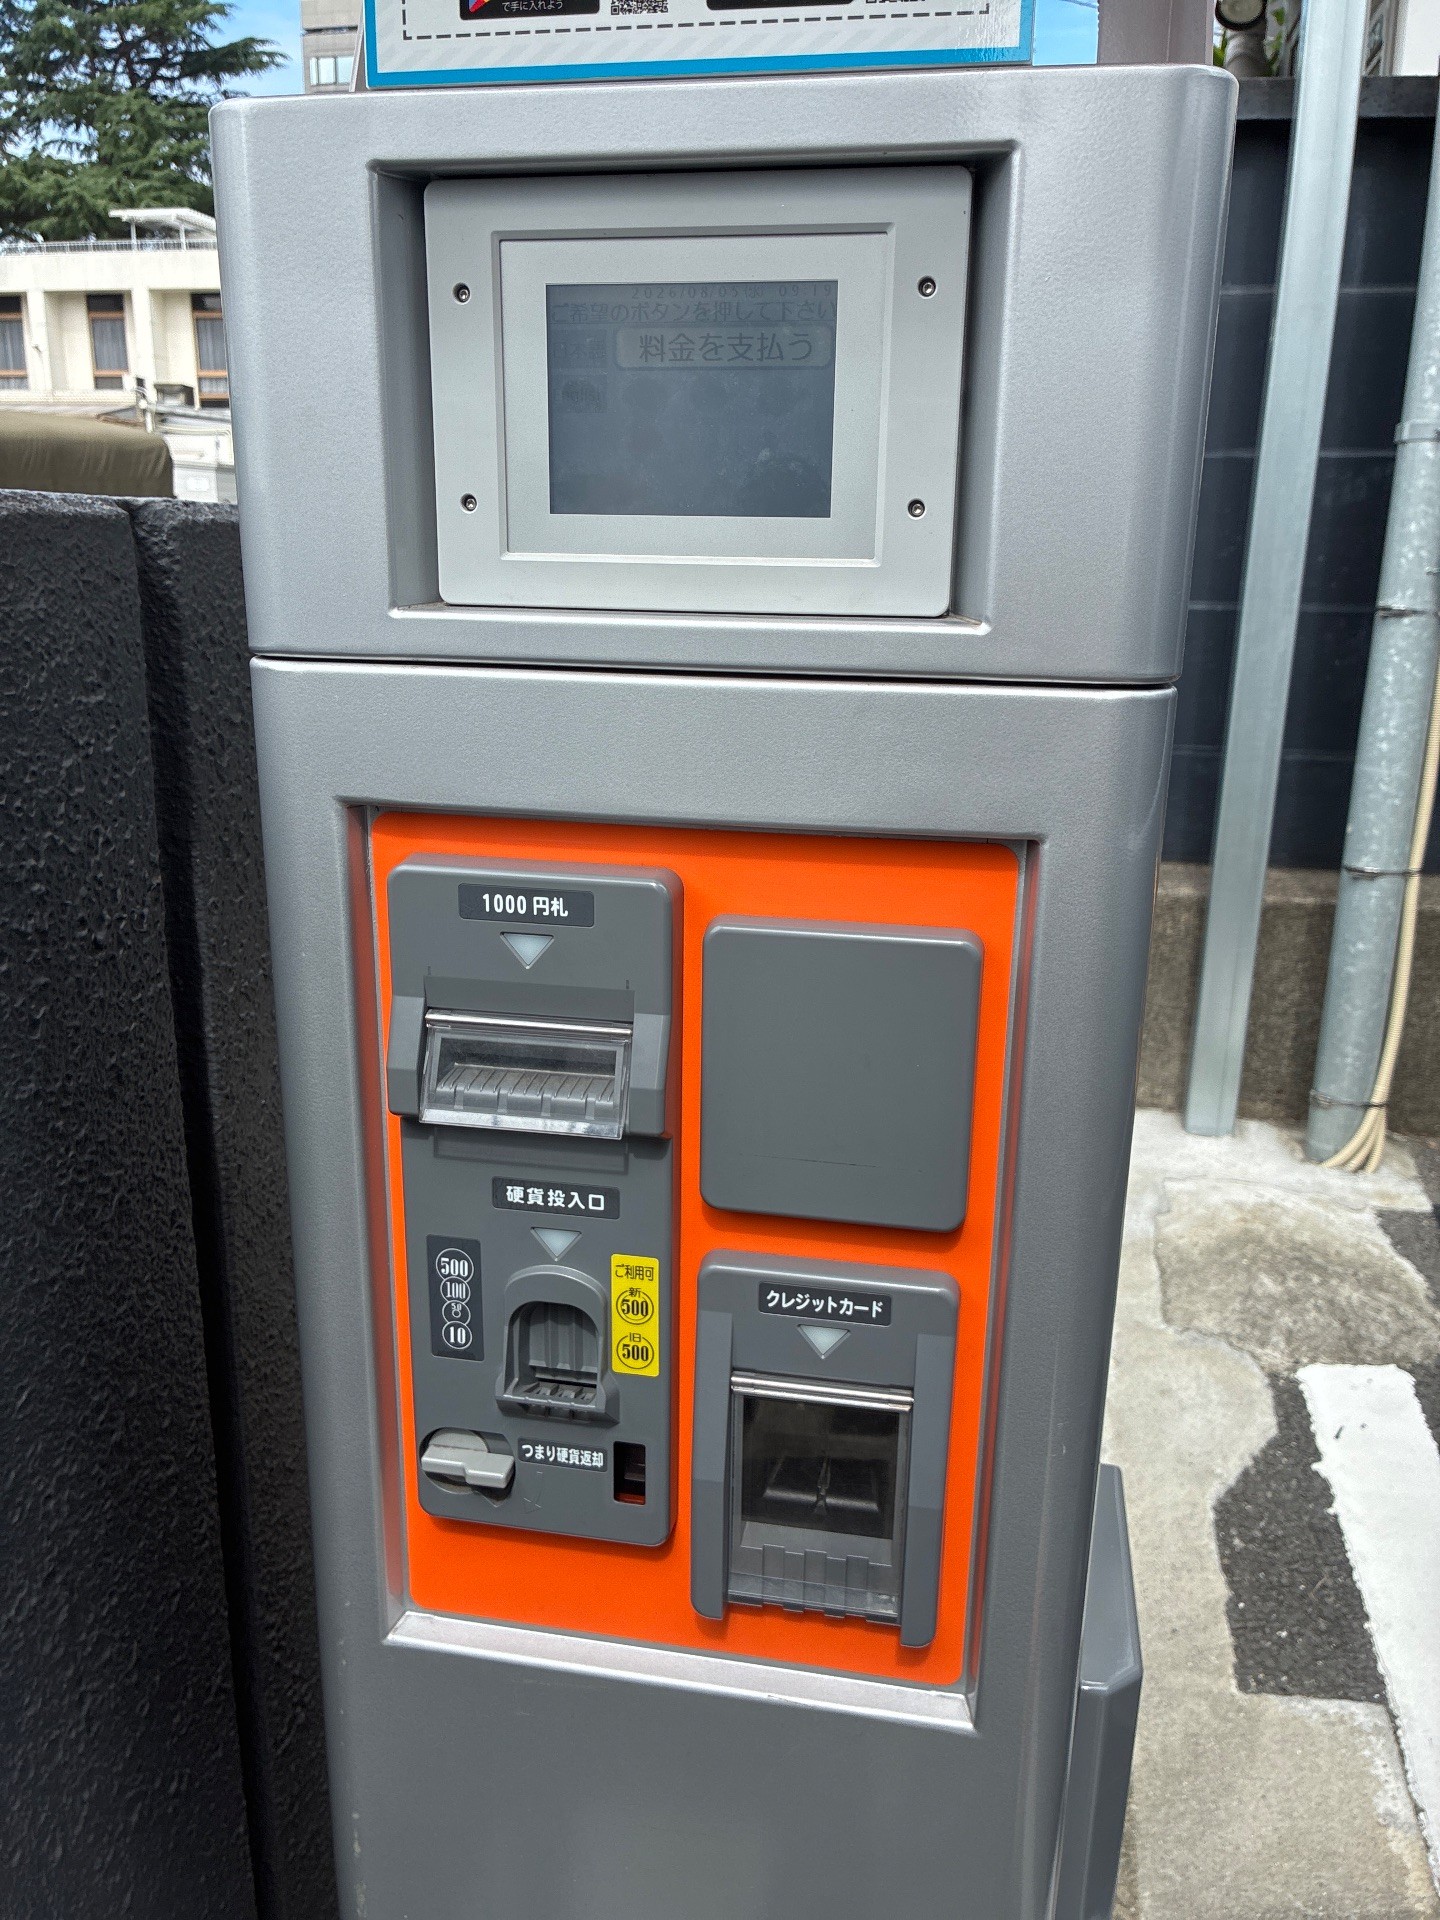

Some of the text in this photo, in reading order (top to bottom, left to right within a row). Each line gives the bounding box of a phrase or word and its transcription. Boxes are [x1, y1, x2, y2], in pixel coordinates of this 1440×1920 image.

[502, 0, 563, 12] で手に入れよう
[639, 332, 814, 363] 料金を支払う
[505, 1185, 605, 1211] 硬貨投入口
[440, 1257, 469, 1277] 500
[615, 1263, 655, 1282] ご利用可
[445, 1281, 466, 1299] 100
[628, 1287, 642, 1298] 新
[451, 1303, 462, 1311] 50
[621, 1299, 649, 1317] 500
[766, 1290, 884, 1318] クレジットカード
[449, 1326, 466, 1344] 10
[629, 1332, 642, 1342] 旧
[621, 1344, 649, 1361] 500
[521, 1444, 604, 1467] つまり硬貨返却
